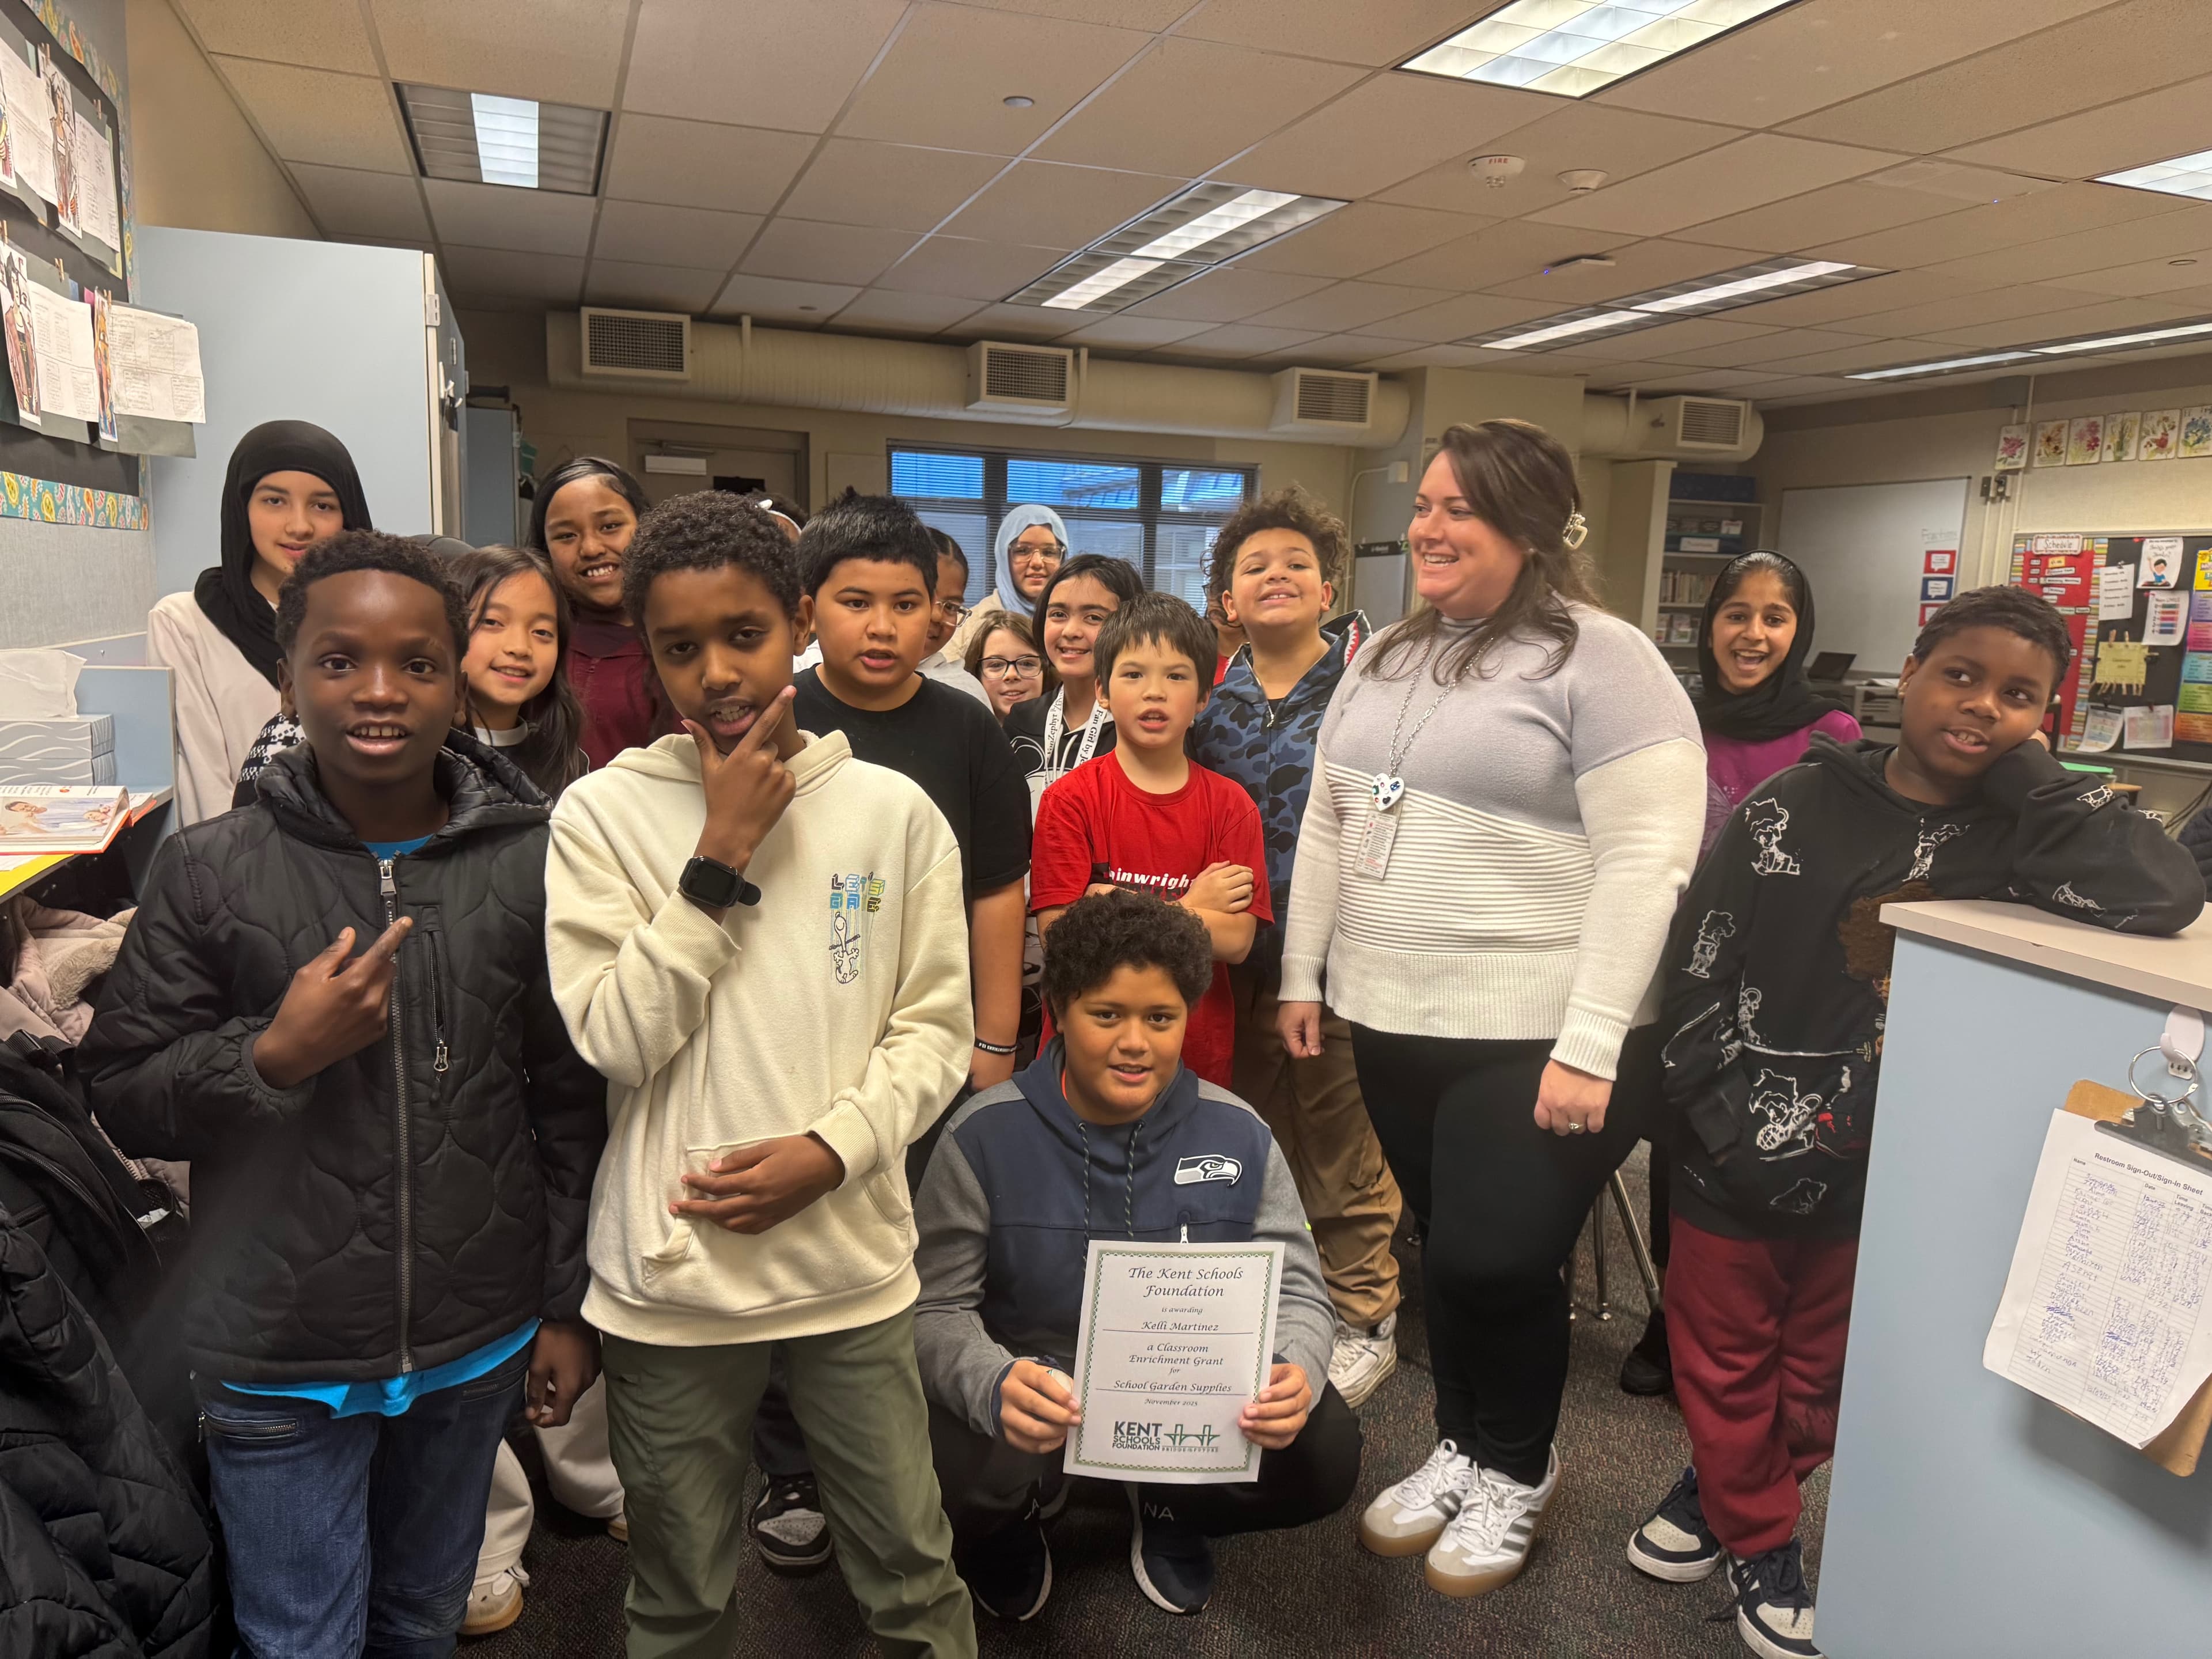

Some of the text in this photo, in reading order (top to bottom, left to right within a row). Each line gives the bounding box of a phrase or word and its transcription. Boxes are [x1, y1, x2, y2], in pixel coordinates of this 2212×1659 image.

[1093, 709, 1103, 725] Fan
[1086, 727, 1097, 744] Girl
[1082, 744, 1093, 754] by
[2073, 1157, 2086, 1166] Name
[2094, 1152, 2126, 1168] Restroom
[2126, 1164, 2181, 1187] Sign-Out/Sign-In
[2182, 1184, 2203, 1196] Sheet
[2144, 1183, 2156, 1191] Date
[2176, 1194, 2189, 1202] Time
[2174, 1200, 2194, 1212] Leaving
[1128, 1267, 1244, 1280] The Kent Schools
[1143, 1285, 1224, 1298] Foundation
[1168, 1306, 1203, 1315] awarding
[1141, 1321, 1219, 1331] Kelli Martinez
[1157, 1342, 1209, 1353] Classroom
[1128, 1354, 1224, 1367] Enrichment Grant
[1168, 1367, 1181, 1376] for
[1113, 1380, 1232, 1395] School Garden Supplies
[1144, 1398, 1180, 1406] November
[1114, 1421, 1162, 1437] KENT
[1113, 1435, 1161, 1445] SCHOOLS
[1112, 1442, 1160, 1451] FOUNDATION
